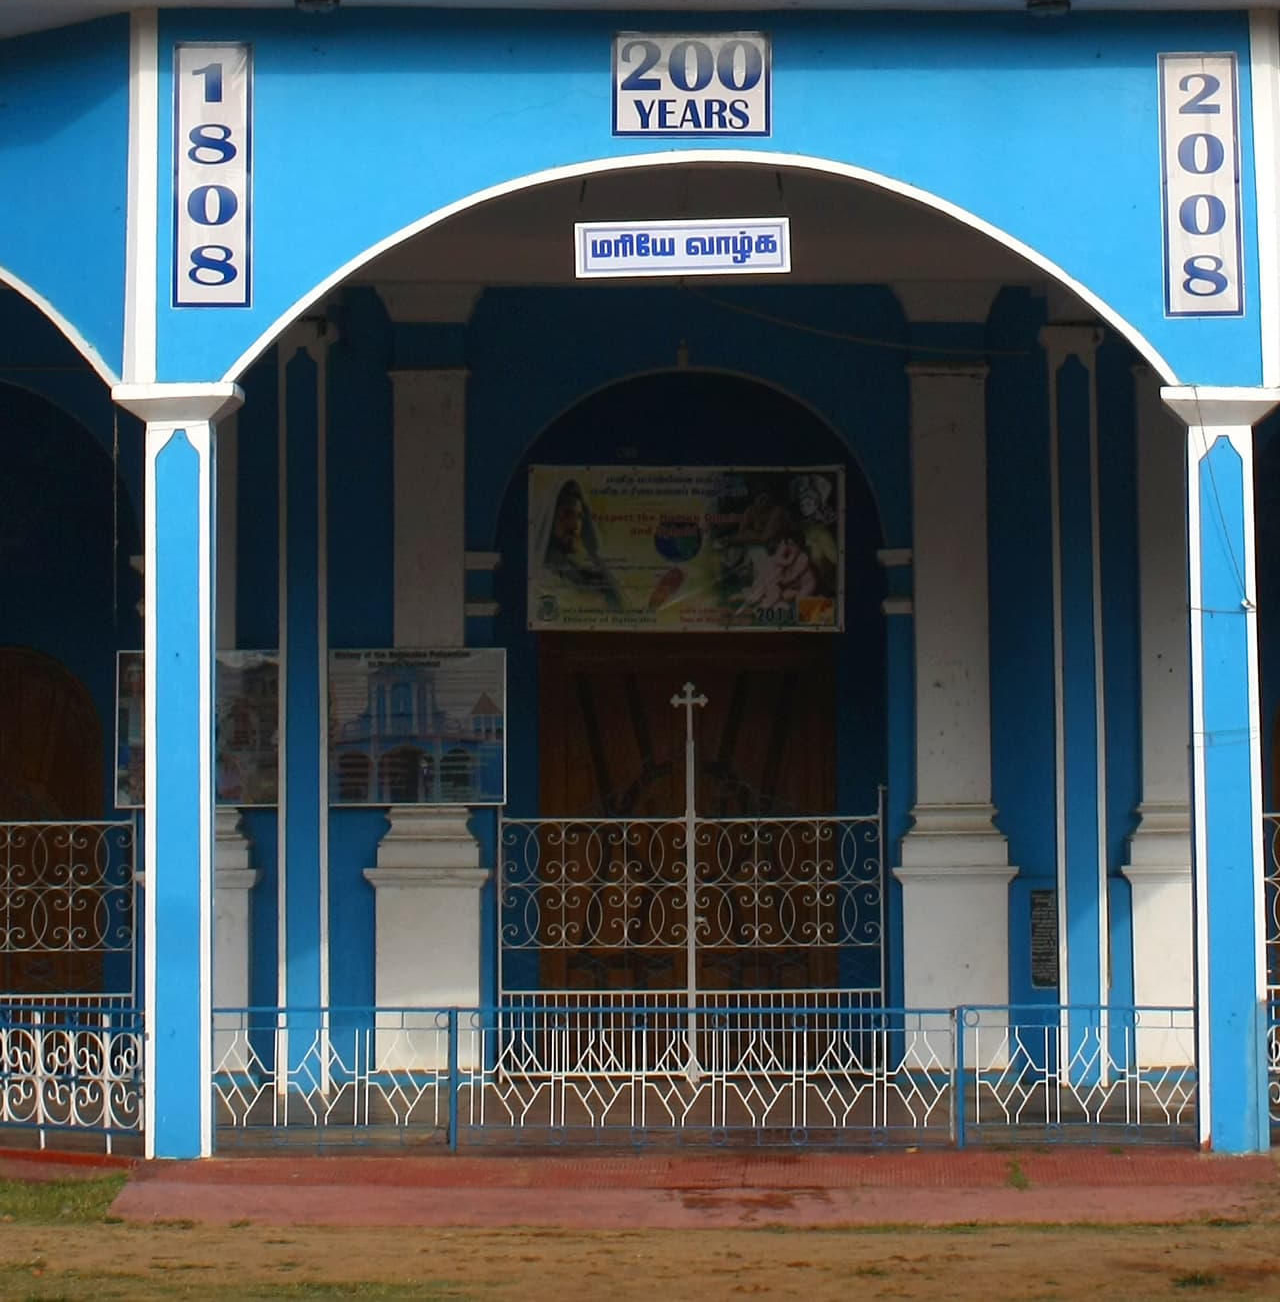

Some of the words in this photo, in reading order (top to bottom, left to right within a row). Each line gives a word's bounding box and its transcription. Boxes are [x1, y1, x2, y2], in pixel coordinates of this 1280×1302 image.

[620, 39, 762, 92] 200
[634, 98, 750, 130] YEARS
[187, 62, 238, 286] 1808
[1177, 72, 1228, 297] 2008
[591, 233, 675, 259] மரியே
[685, 231, 777, 264] வாழ்க
[756, 606, 795, 623] 2014
